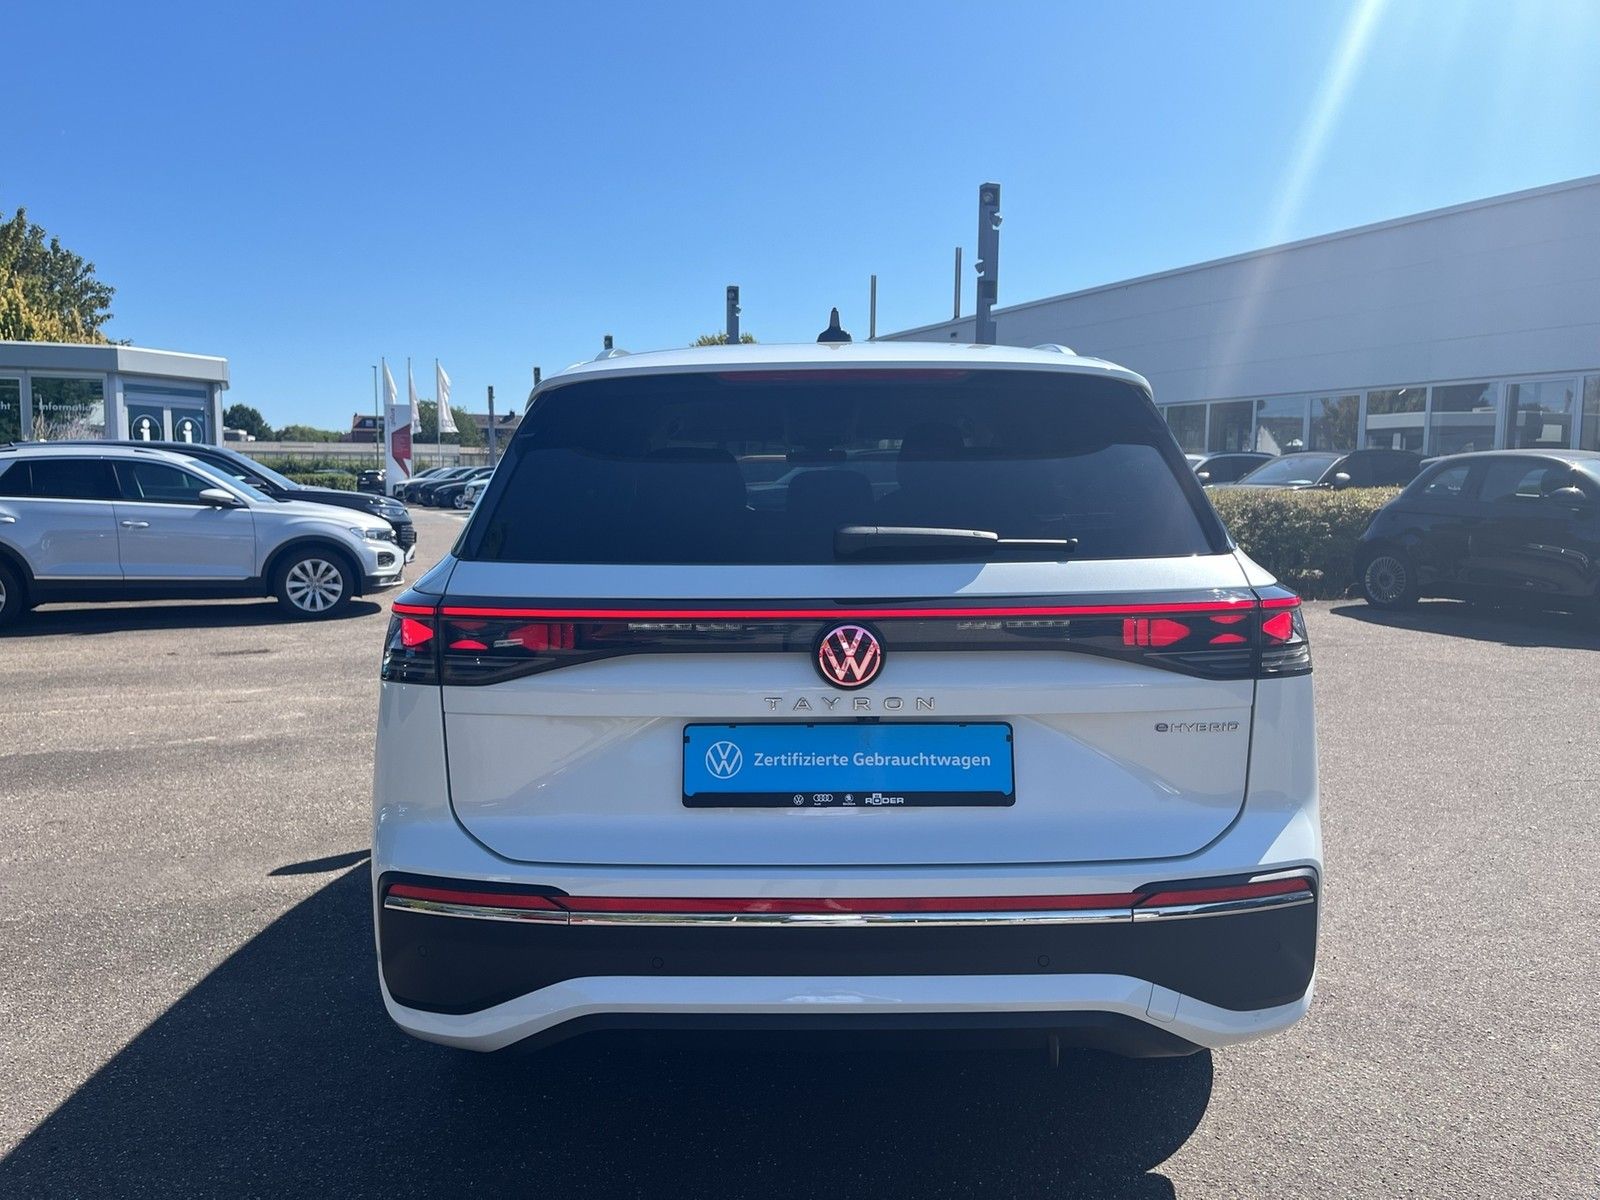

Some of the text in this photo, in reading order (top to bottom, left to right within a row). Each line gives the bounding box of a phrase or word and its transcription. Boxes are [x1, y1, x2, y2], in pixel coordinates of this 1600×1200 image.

[764, 697, 936, 711] TAYRON
[754, 752, 991, 770] Zertifizierte Gebrauchtwagen
